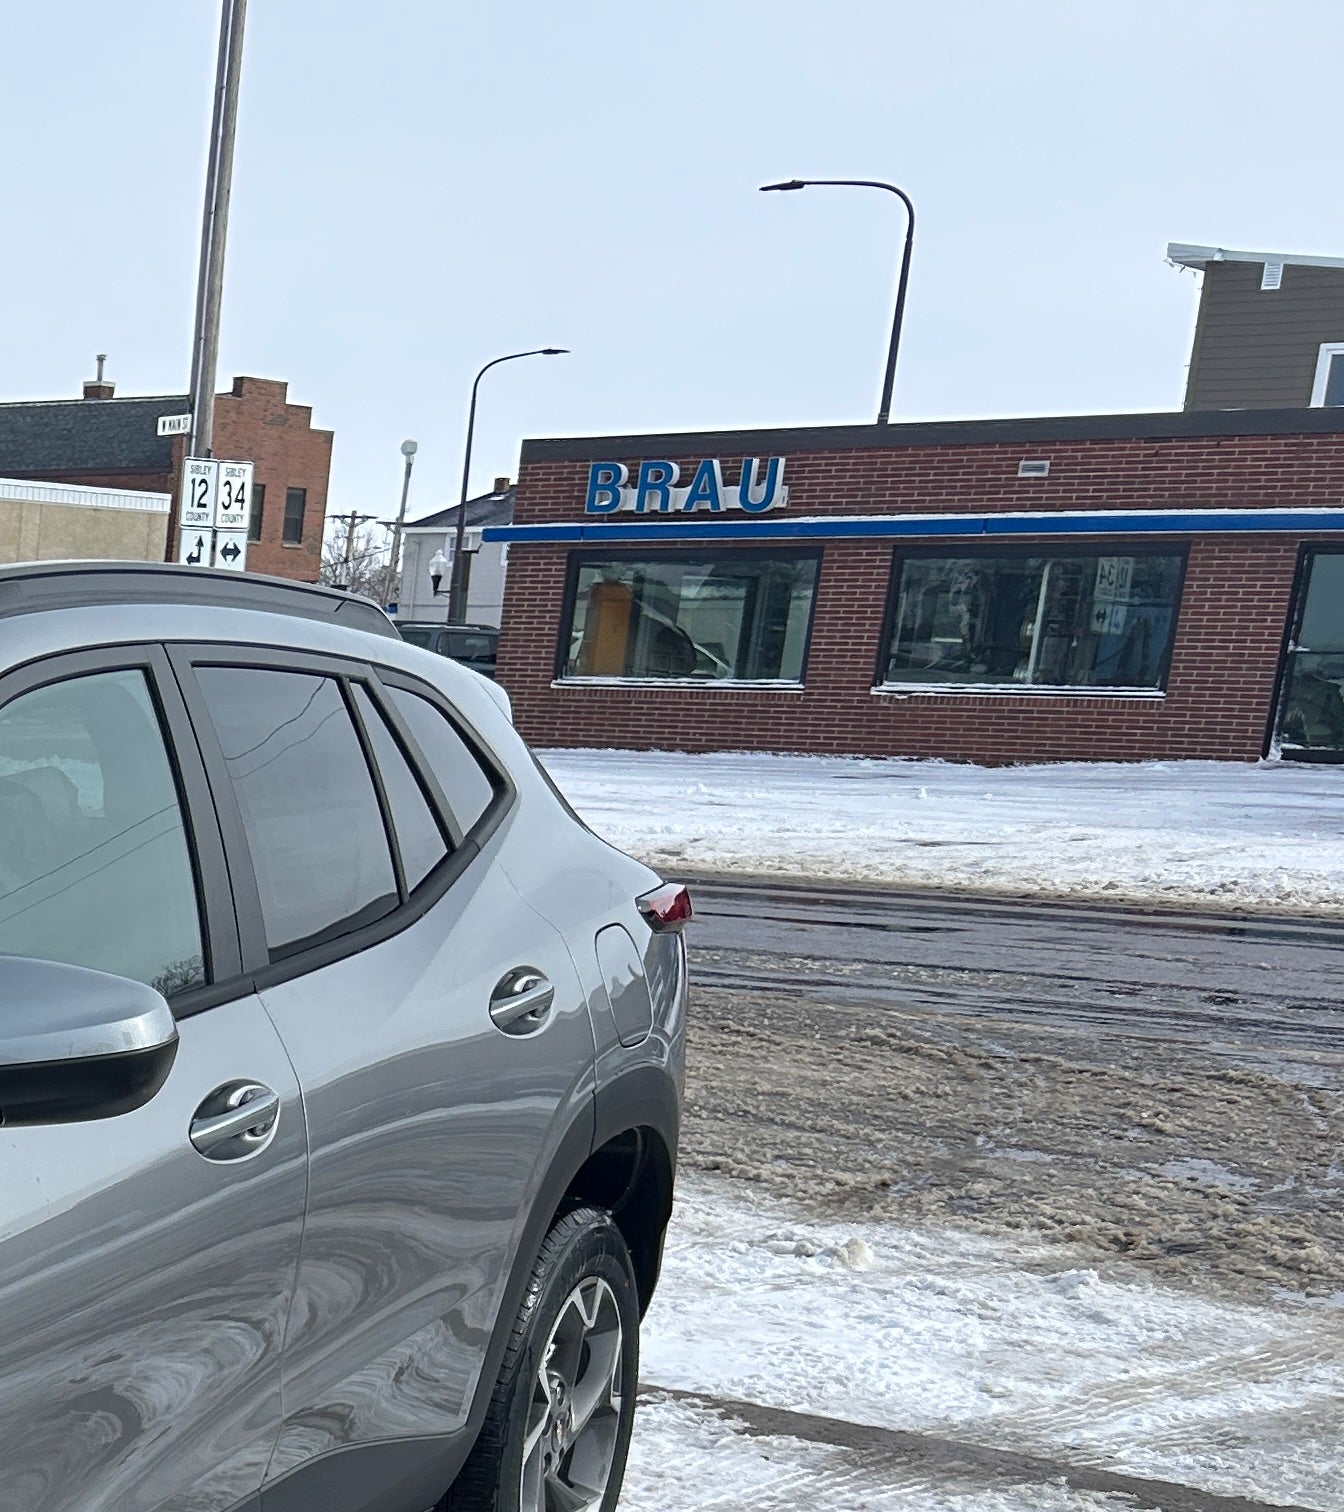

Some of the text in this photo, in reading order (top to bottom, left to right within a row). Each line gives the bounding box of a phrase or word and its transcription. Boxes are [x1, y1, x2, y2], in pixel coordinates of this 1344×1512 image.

[190, 464, 212, 475] SIBLEY
[225, 467, 247, 478] SIBLEY
[585, 457, 786, 514] BRAU
[190, 477, 208, 509] 12
[221, 480, 245, 511] 34
[186, 510, 210, 522] COUNTY
[220, 513, 244, 524] COUNTY
